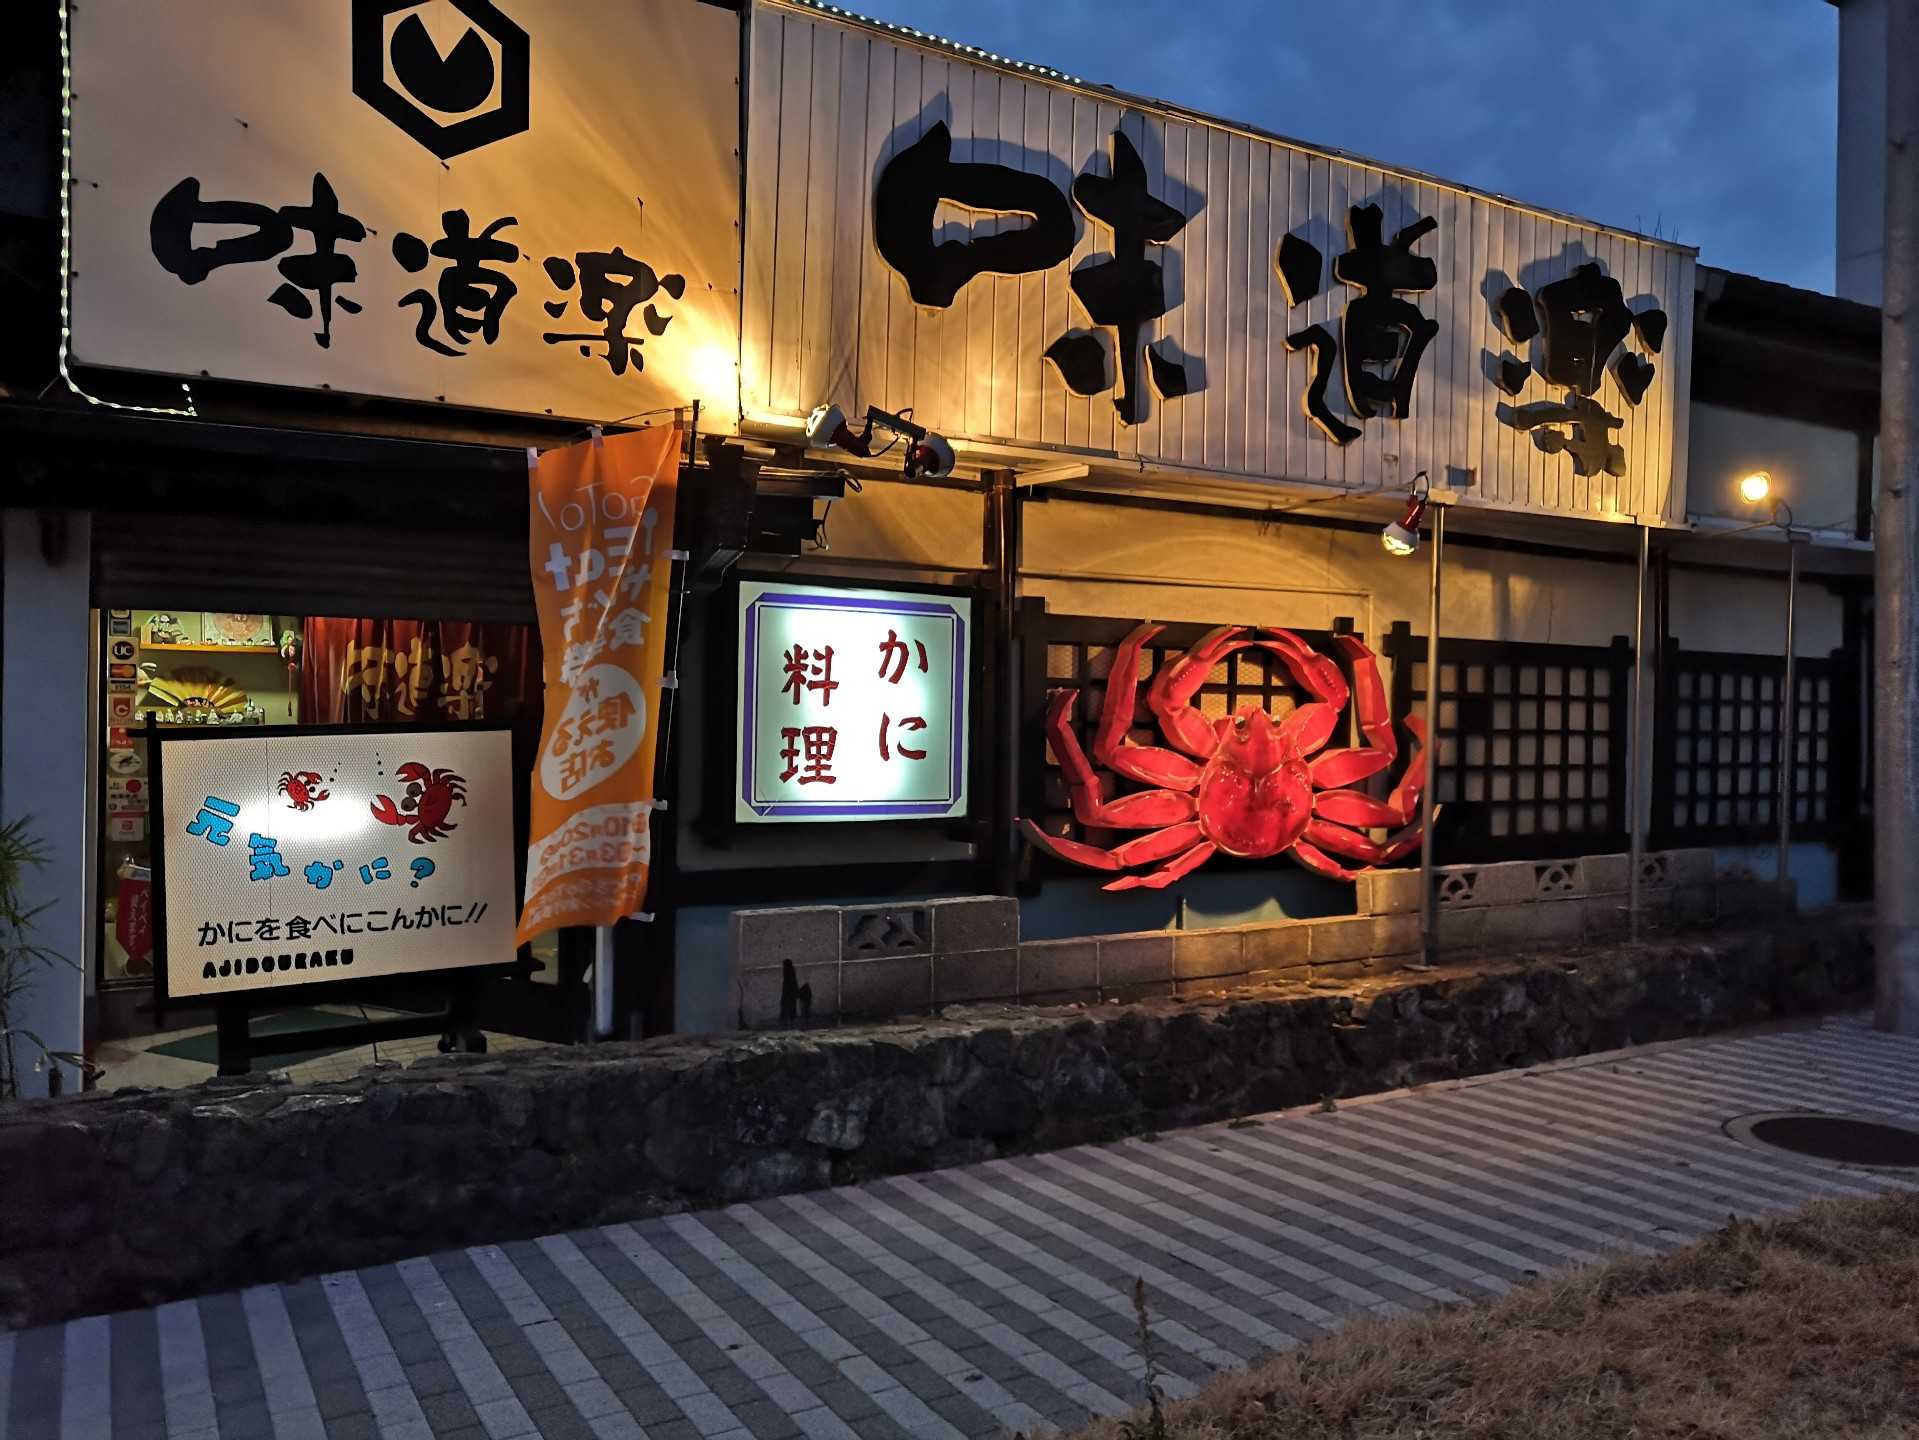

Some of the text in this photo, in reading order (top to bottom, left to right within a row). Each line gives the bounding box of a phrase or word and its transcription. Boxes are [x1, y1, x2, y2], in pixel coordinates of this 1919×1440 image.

[150, 172, 685, 375] 味道楽
[874, 120, 1667, 477] 味道楽
[778, 643, 839, 785] 料理
[878, 628, 928, 761] かに
[197, 902, 488, 947] かにを食べにこんかに!!
[202, 948, 354, 979] AJIDOURAKU
